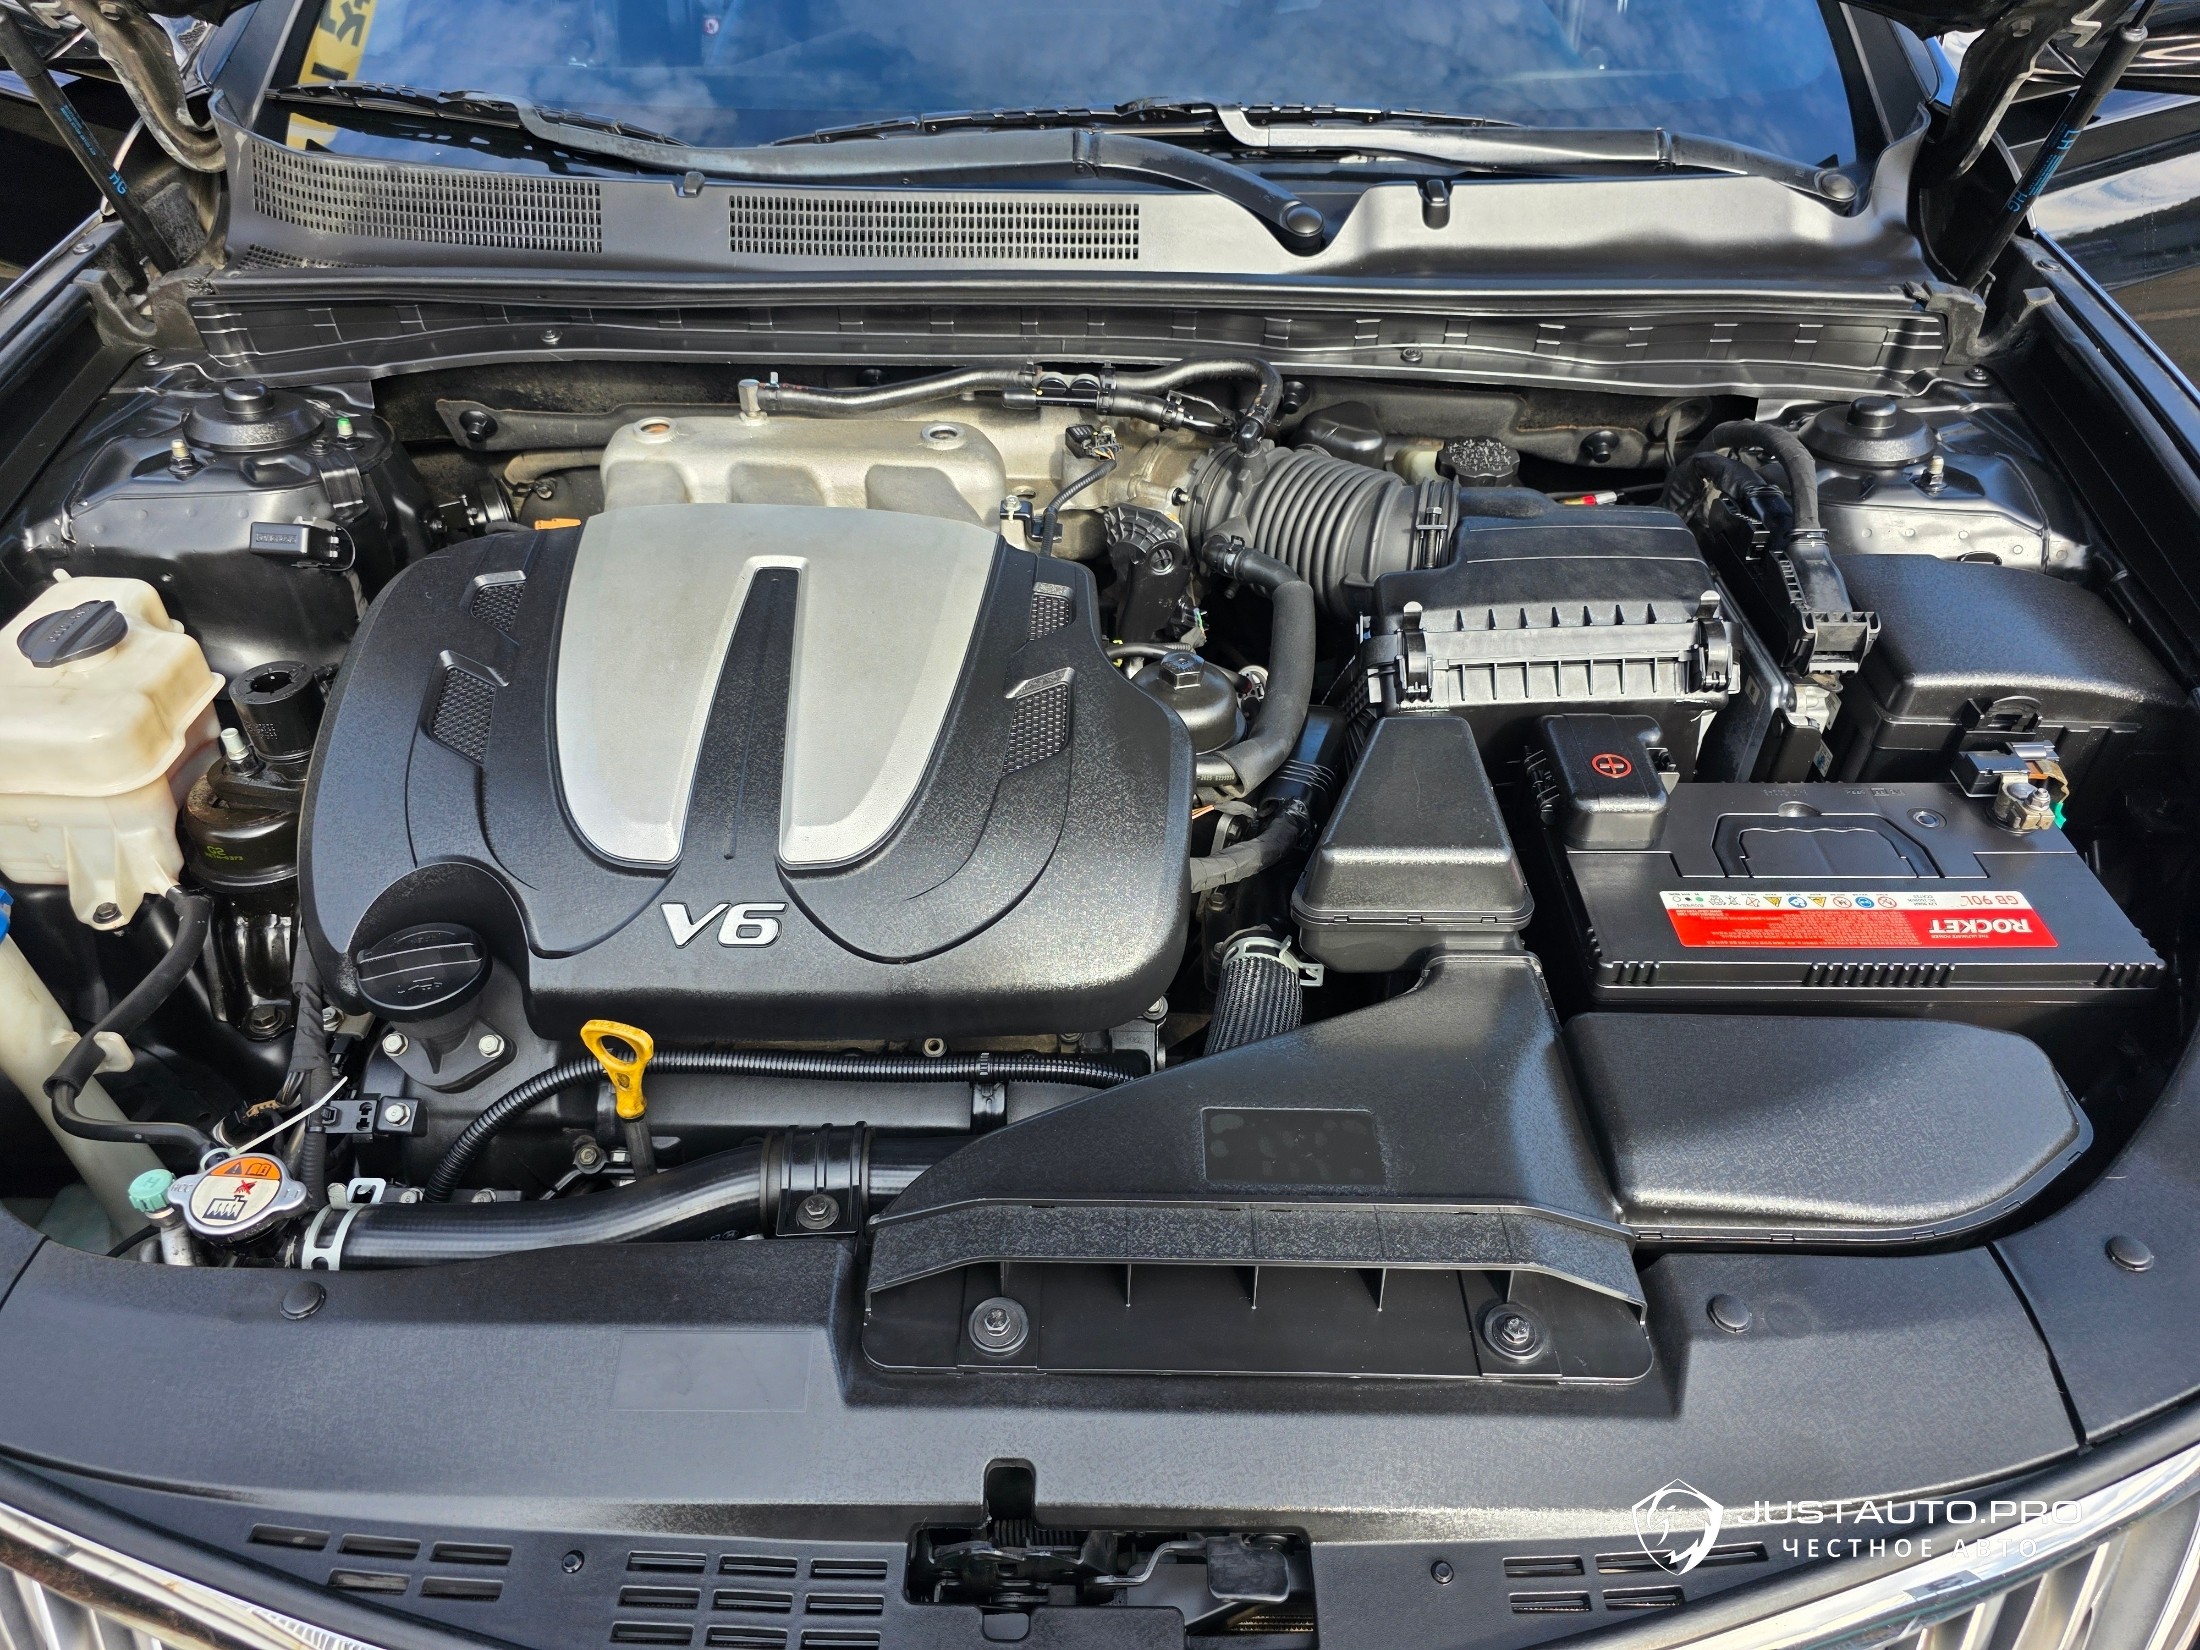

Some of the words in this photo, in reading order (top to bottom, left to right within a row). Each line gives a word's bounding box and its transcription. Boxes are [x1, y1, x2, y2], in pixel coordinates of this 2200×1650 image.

[2057, 129, 2081, 150] LH
[1994, 894, 2019, 906] GB
[660, 901, 789, 949] V6
[1928, 918, 2033, 934] ROCKET
